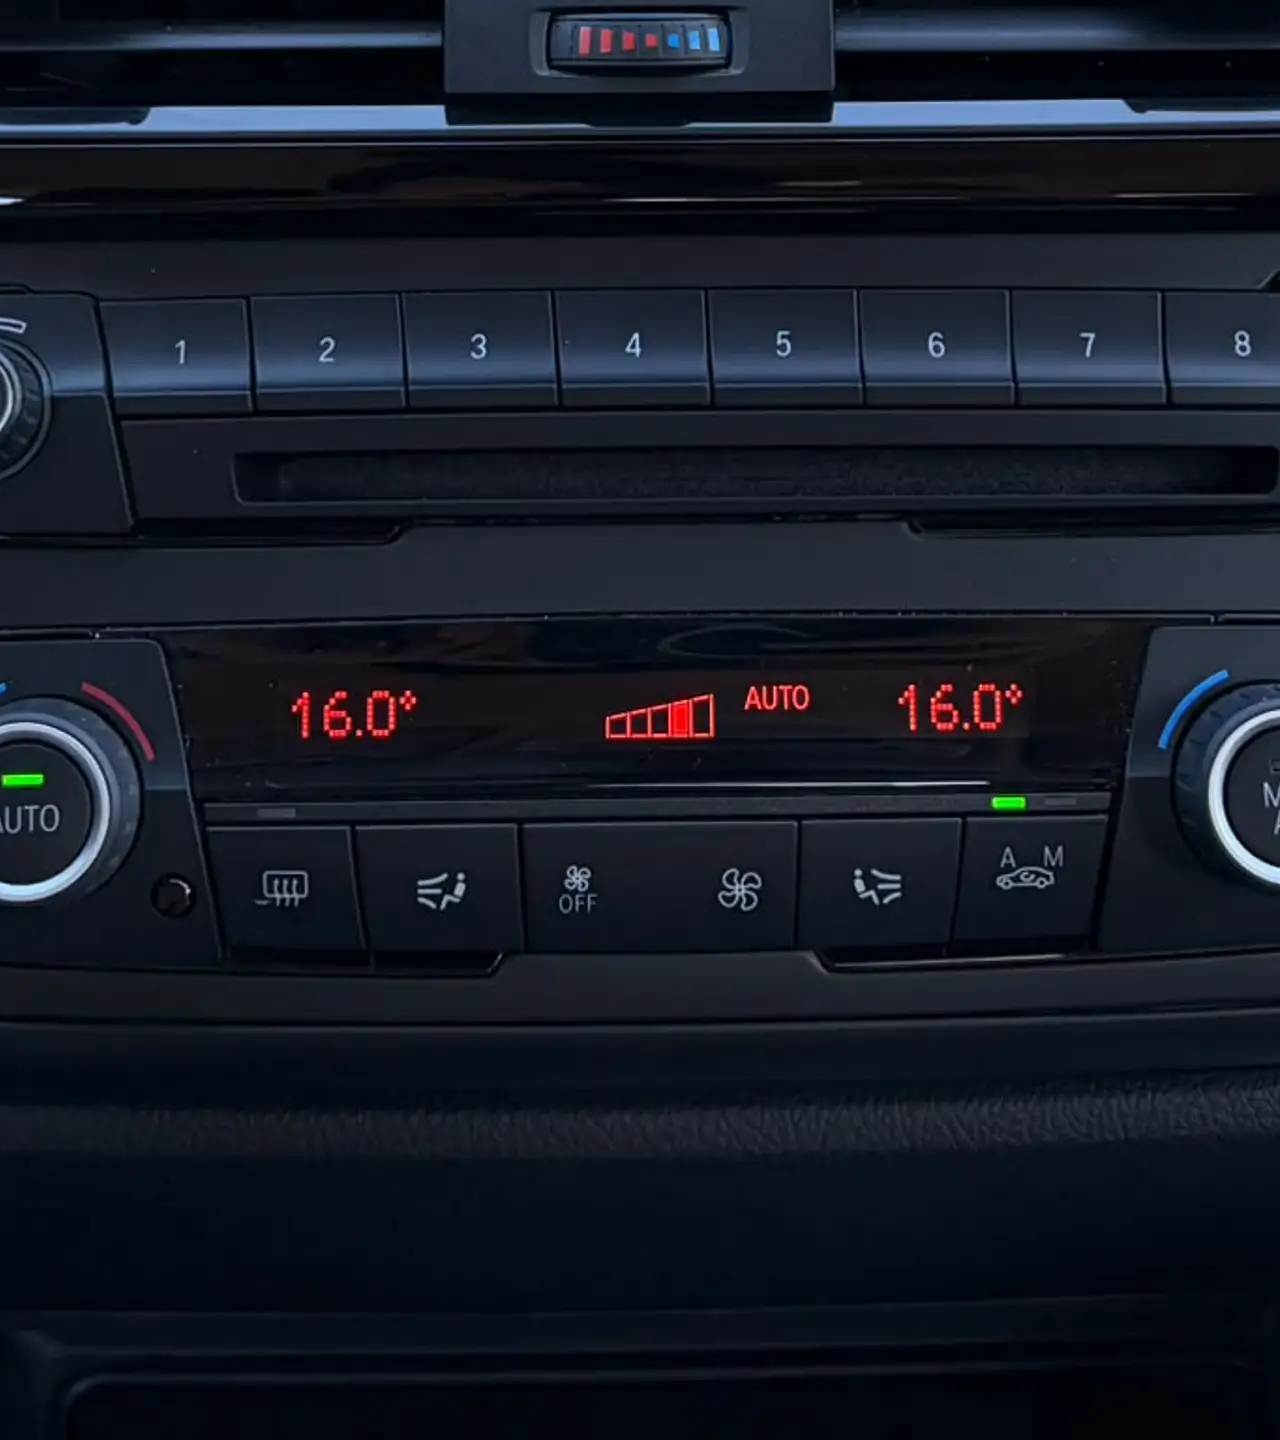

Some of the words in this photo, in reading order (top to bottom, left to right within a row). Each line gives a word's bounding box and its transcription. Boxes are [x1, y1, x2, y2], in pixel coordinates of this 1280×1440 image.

[173, 340, 189, 365] 1
[319, 337, 337, 364] 2
[470, 333, 488, 360] 3
[625, 332, 643, 358] 4
[776, 330, 792, 358] 5
[927, 331, 946, 359] 6
[1080, 331, 1096, 359] 7
[1233, 330, 1252, 358] 8
[743, 684, 811, 712] AUTO
[999, 847, 1016, 869] A
[1043, 846, 1065, 868] M
[558, 892, 598, 915] OFF
